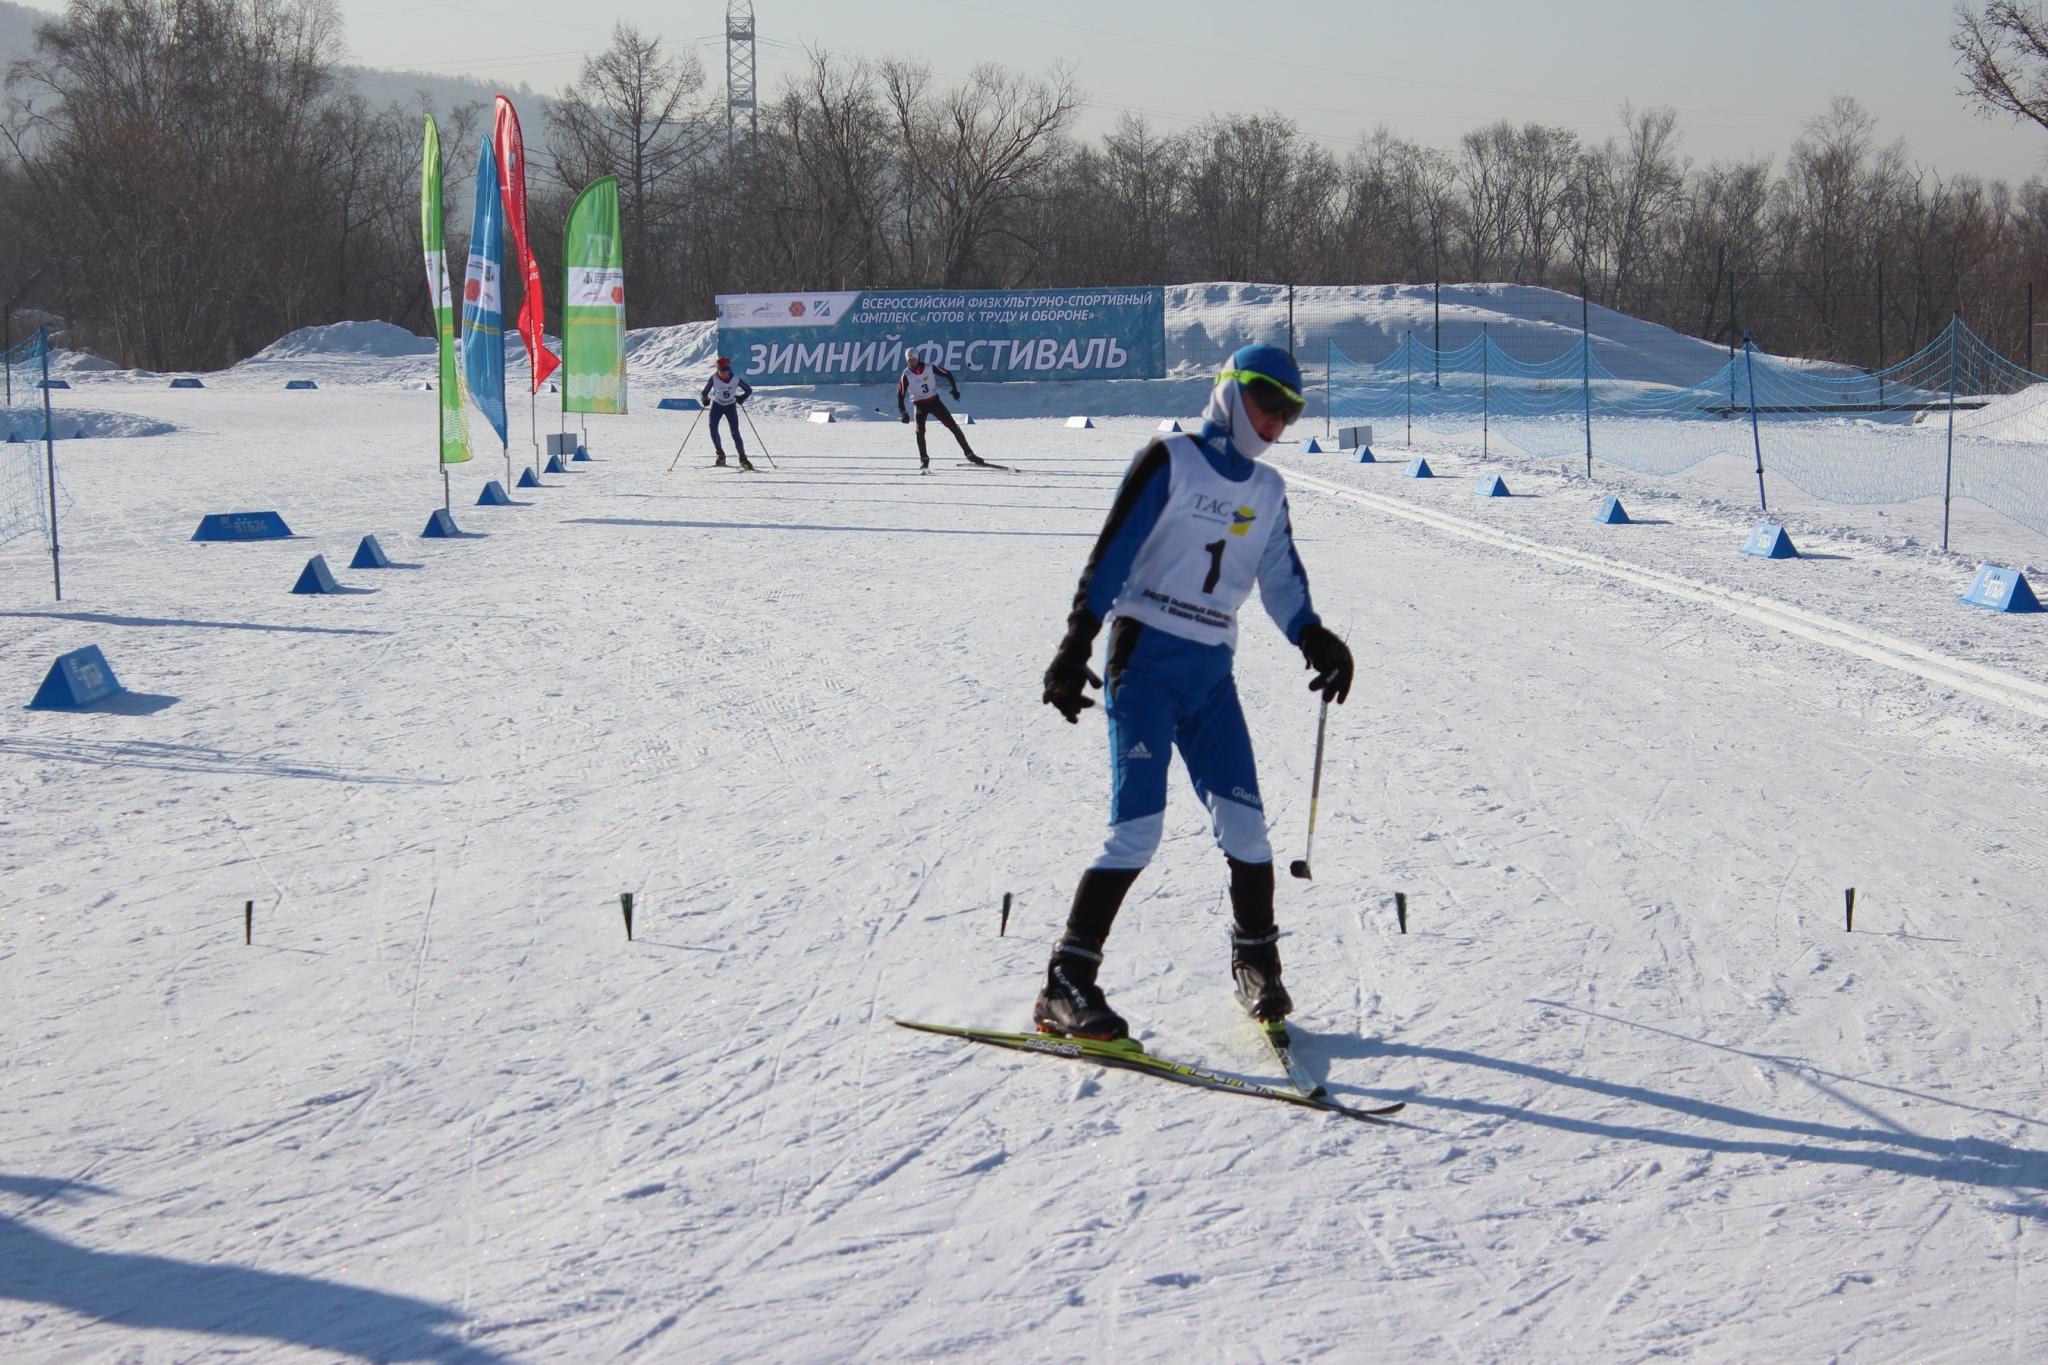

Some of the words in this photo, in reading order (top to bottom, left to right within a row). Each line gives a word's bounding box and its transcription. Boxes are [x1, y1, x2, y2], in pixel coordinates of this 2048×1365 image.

[862, 295, 965, 309] ВСЕРОССИЙСКИЙ
[968, 291, 1152, 308] ФИЗКУЛЬТУРНО-СПОРТИВНЫЙ
[852, 312, 918, 323] КОМПЛЕКС
[920, 311, 964, 322] «ГОТОВ
[967, 311, 976, 321] К
[979, 310, 1018, 323] ТРУДУ
[1019, 310, 1028, 321] И
[1031, 309, 1095, 321] ОБОРОНЕ»
[746, 334, 903, 376] ЗИМНИЙ
[916, 337, 1128, 373] ФЕСТИВАЛЬ
[723, 390, 730, 399] 5
[921, 383, 929, 393] 3
[1202, 539, 1226, 594] 1
